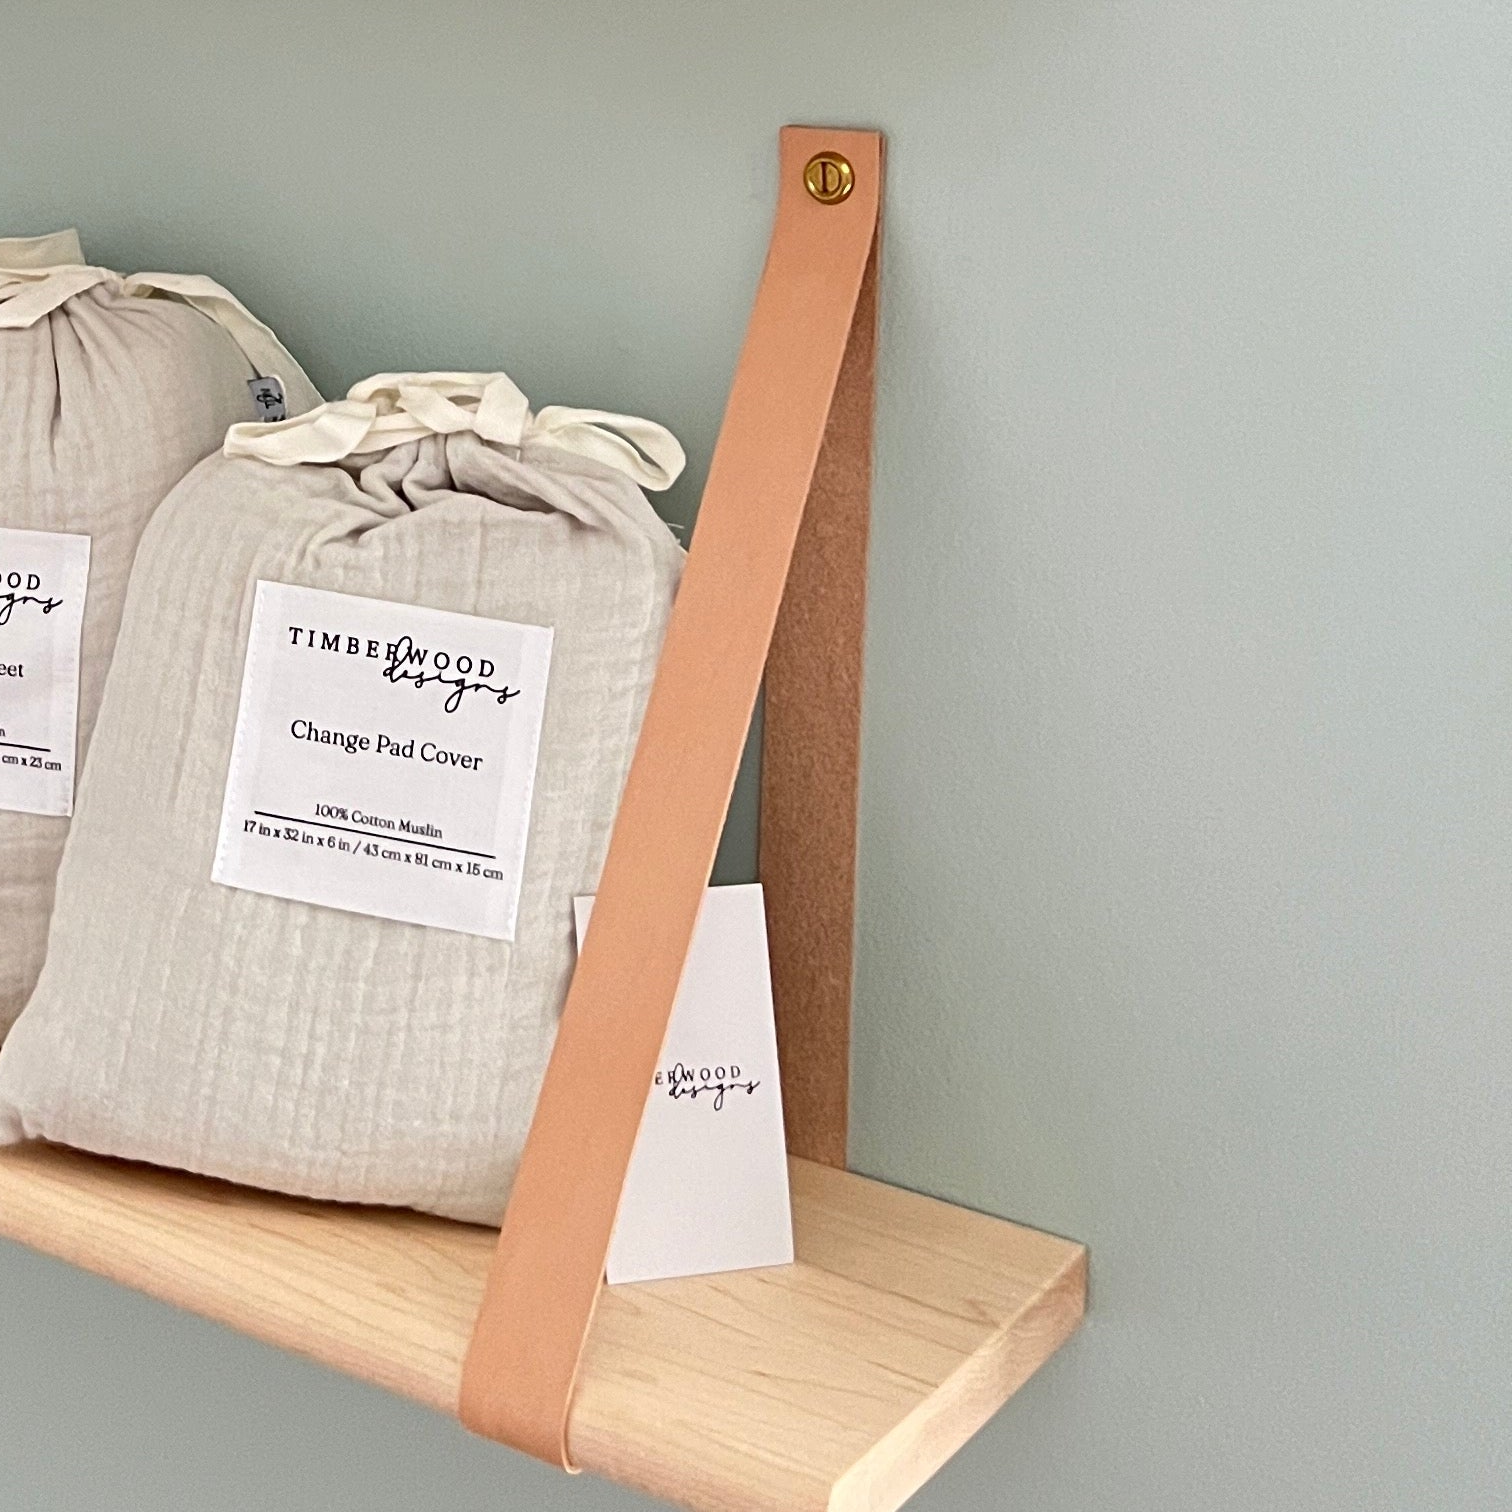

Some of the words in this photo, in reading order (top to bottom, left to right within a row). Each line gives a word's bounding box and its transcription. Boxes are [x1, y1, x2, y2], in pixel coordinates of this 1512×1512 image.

[383, 636, 520, 713] designs
[1, 754, 19, 765] cm
[20, 757, 28, 767] x
[29, 755, 43, 769] 23
[44, 761, 62, 772] cm
[291, 720, 370, 754] Change
[376, 734, 414, 758] Pad
[421, 743, 483, 770] Cover
[315, 804, 348, 820] 100%
[352, 811, 395, 830] Cotton
[399, 819, 442, 838] Muslin
[243, 819, 257, 833] 17
[258, 822, 271, 837] in
[272, 828, 282, 839] x
[282, 827, 300, 842] 32
[301, 831, 314, 845] in
[316, 836, 325, 847] x
[338, 837, 351, 853] in
[363, 842, 379, 857] 43
[381, 849, 402, 862] cm
[403, 853, 412, 864] x
[431, 858, 452, 871] cm
[455, 863, 463, 873] x
[482, 868, 504, 881] cm
[655, 1066, 741, 1085] ERWOOD
[669, 1063, 760, 1111] designs
